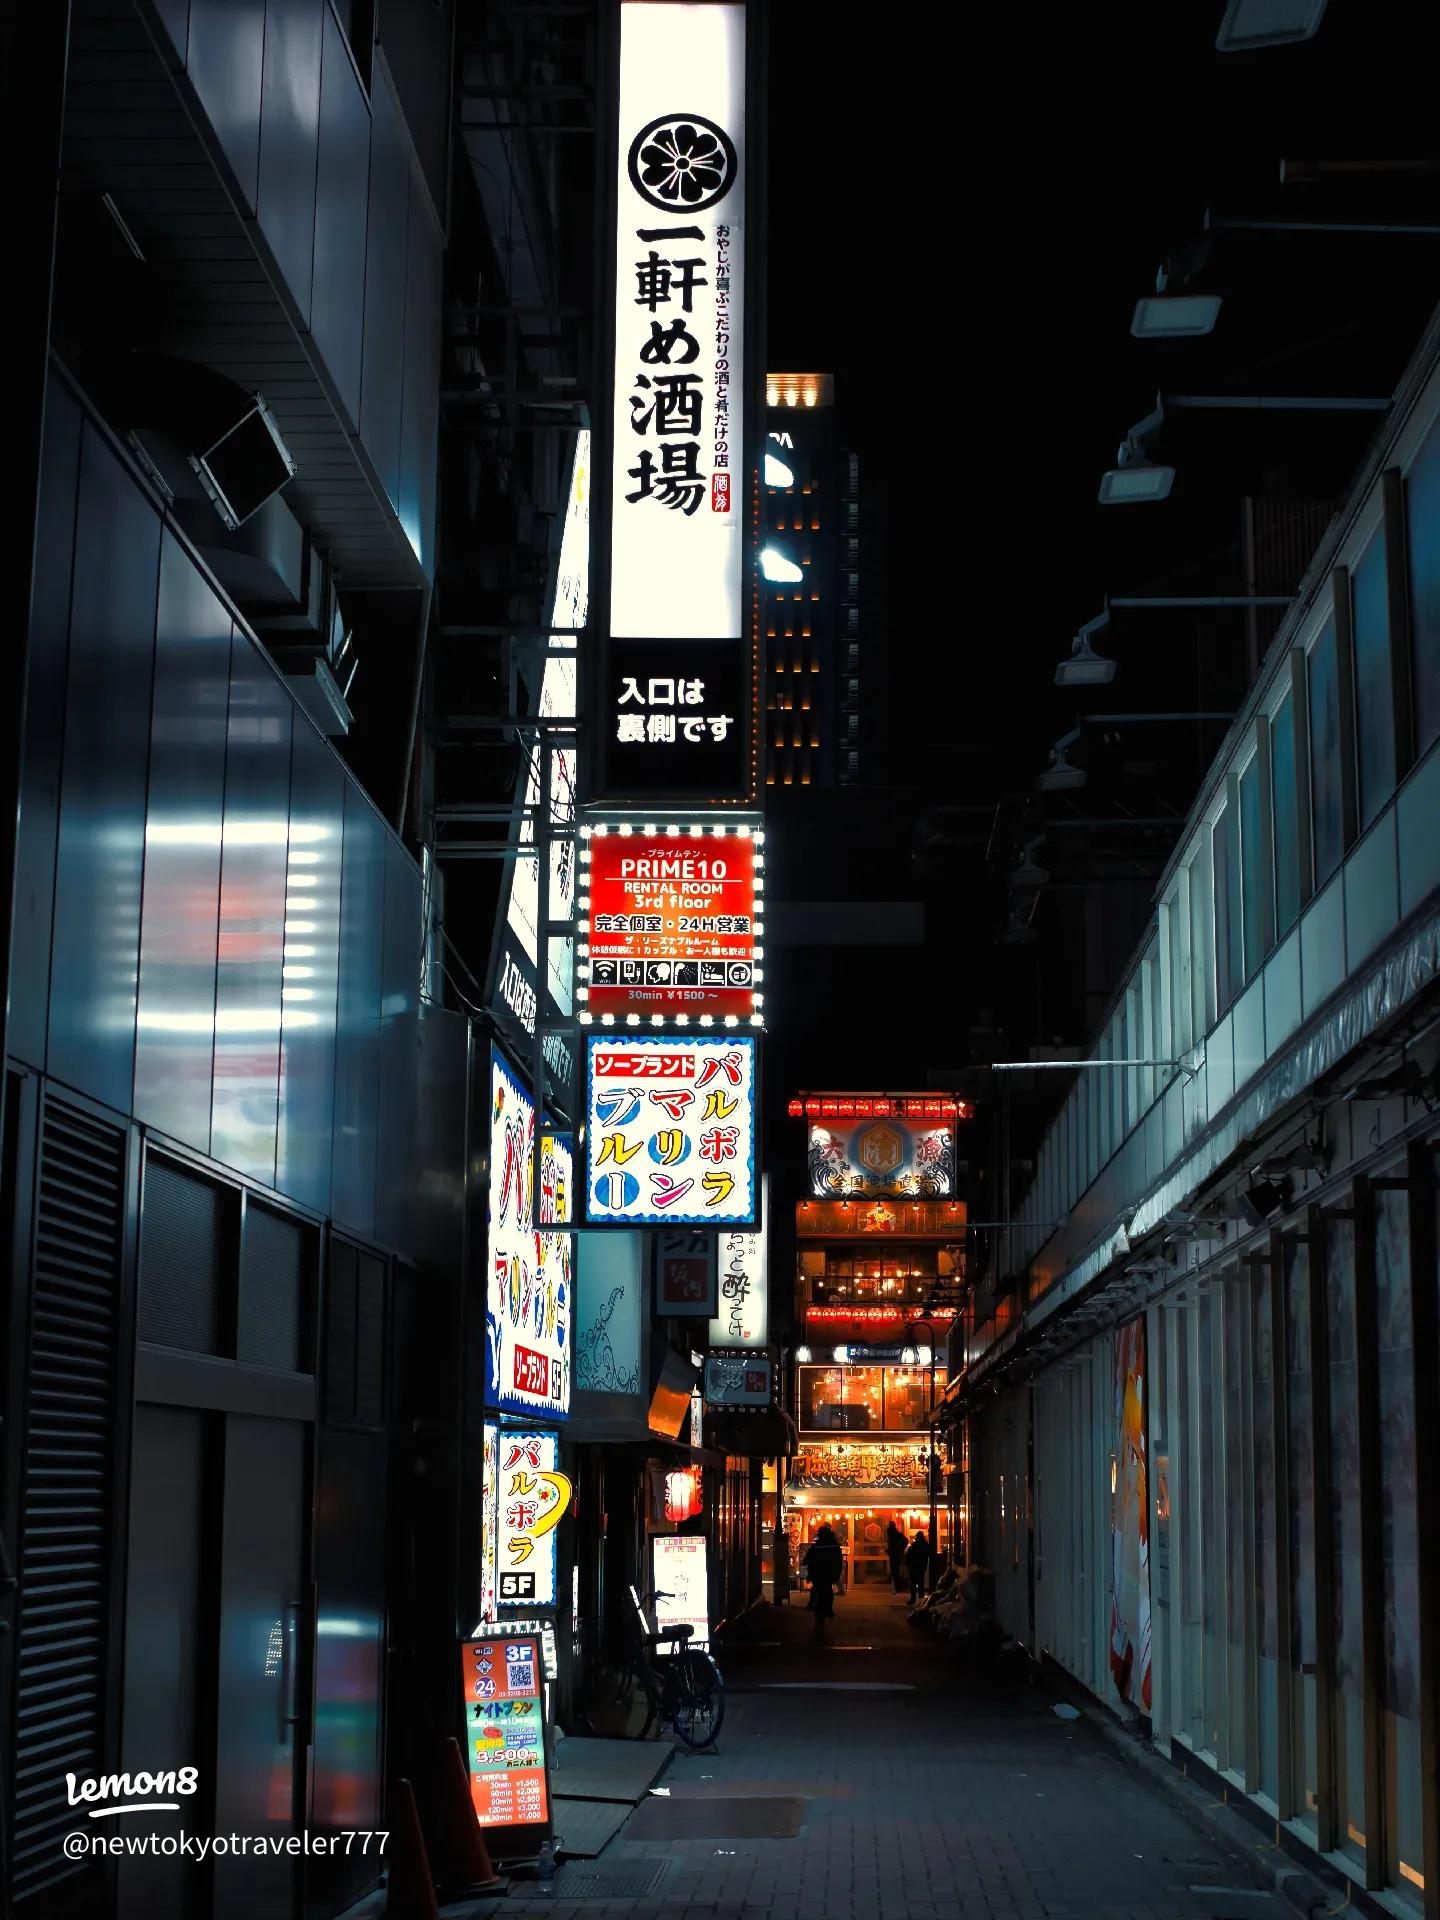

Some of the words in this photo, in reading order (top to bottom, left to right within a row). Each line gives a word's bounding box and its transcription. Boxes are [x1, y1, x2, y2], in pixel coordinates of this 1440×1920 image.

[714, 225, 730, 467] おやじが喜ぶこだわりの酒と肴だけの店
[625, 224, 708, 517] 一軒め酒場
[617, 678, 705, 705] 入口は
[617, 714, 734, 742] 裏側です
[648, 849, 700, 858] プライムテン
[621, 859, 727, 879] PRIME10
[624, 882, 677, 894] RENTAL
[682, 883, 722, 894] ROOM
[635, 895, 663, 908] 3rd
[669, 896, 711, 908] floor
[628, 990, 662, 999] 30min
[598, 1056, 694, 1076] ソープランド
[695, 1052, 742, 1207] バルボラ
[516, 1350, 547, 1391] ソープランド
[552, 1361, 561, 1397] 5F
[503, 1441, 541, 1566] バルボラ
[503, 1576, 532, 1595] 5F
[506, 1646, 532, 1661] 3F
[476, 1680, 495, 1694] 24
